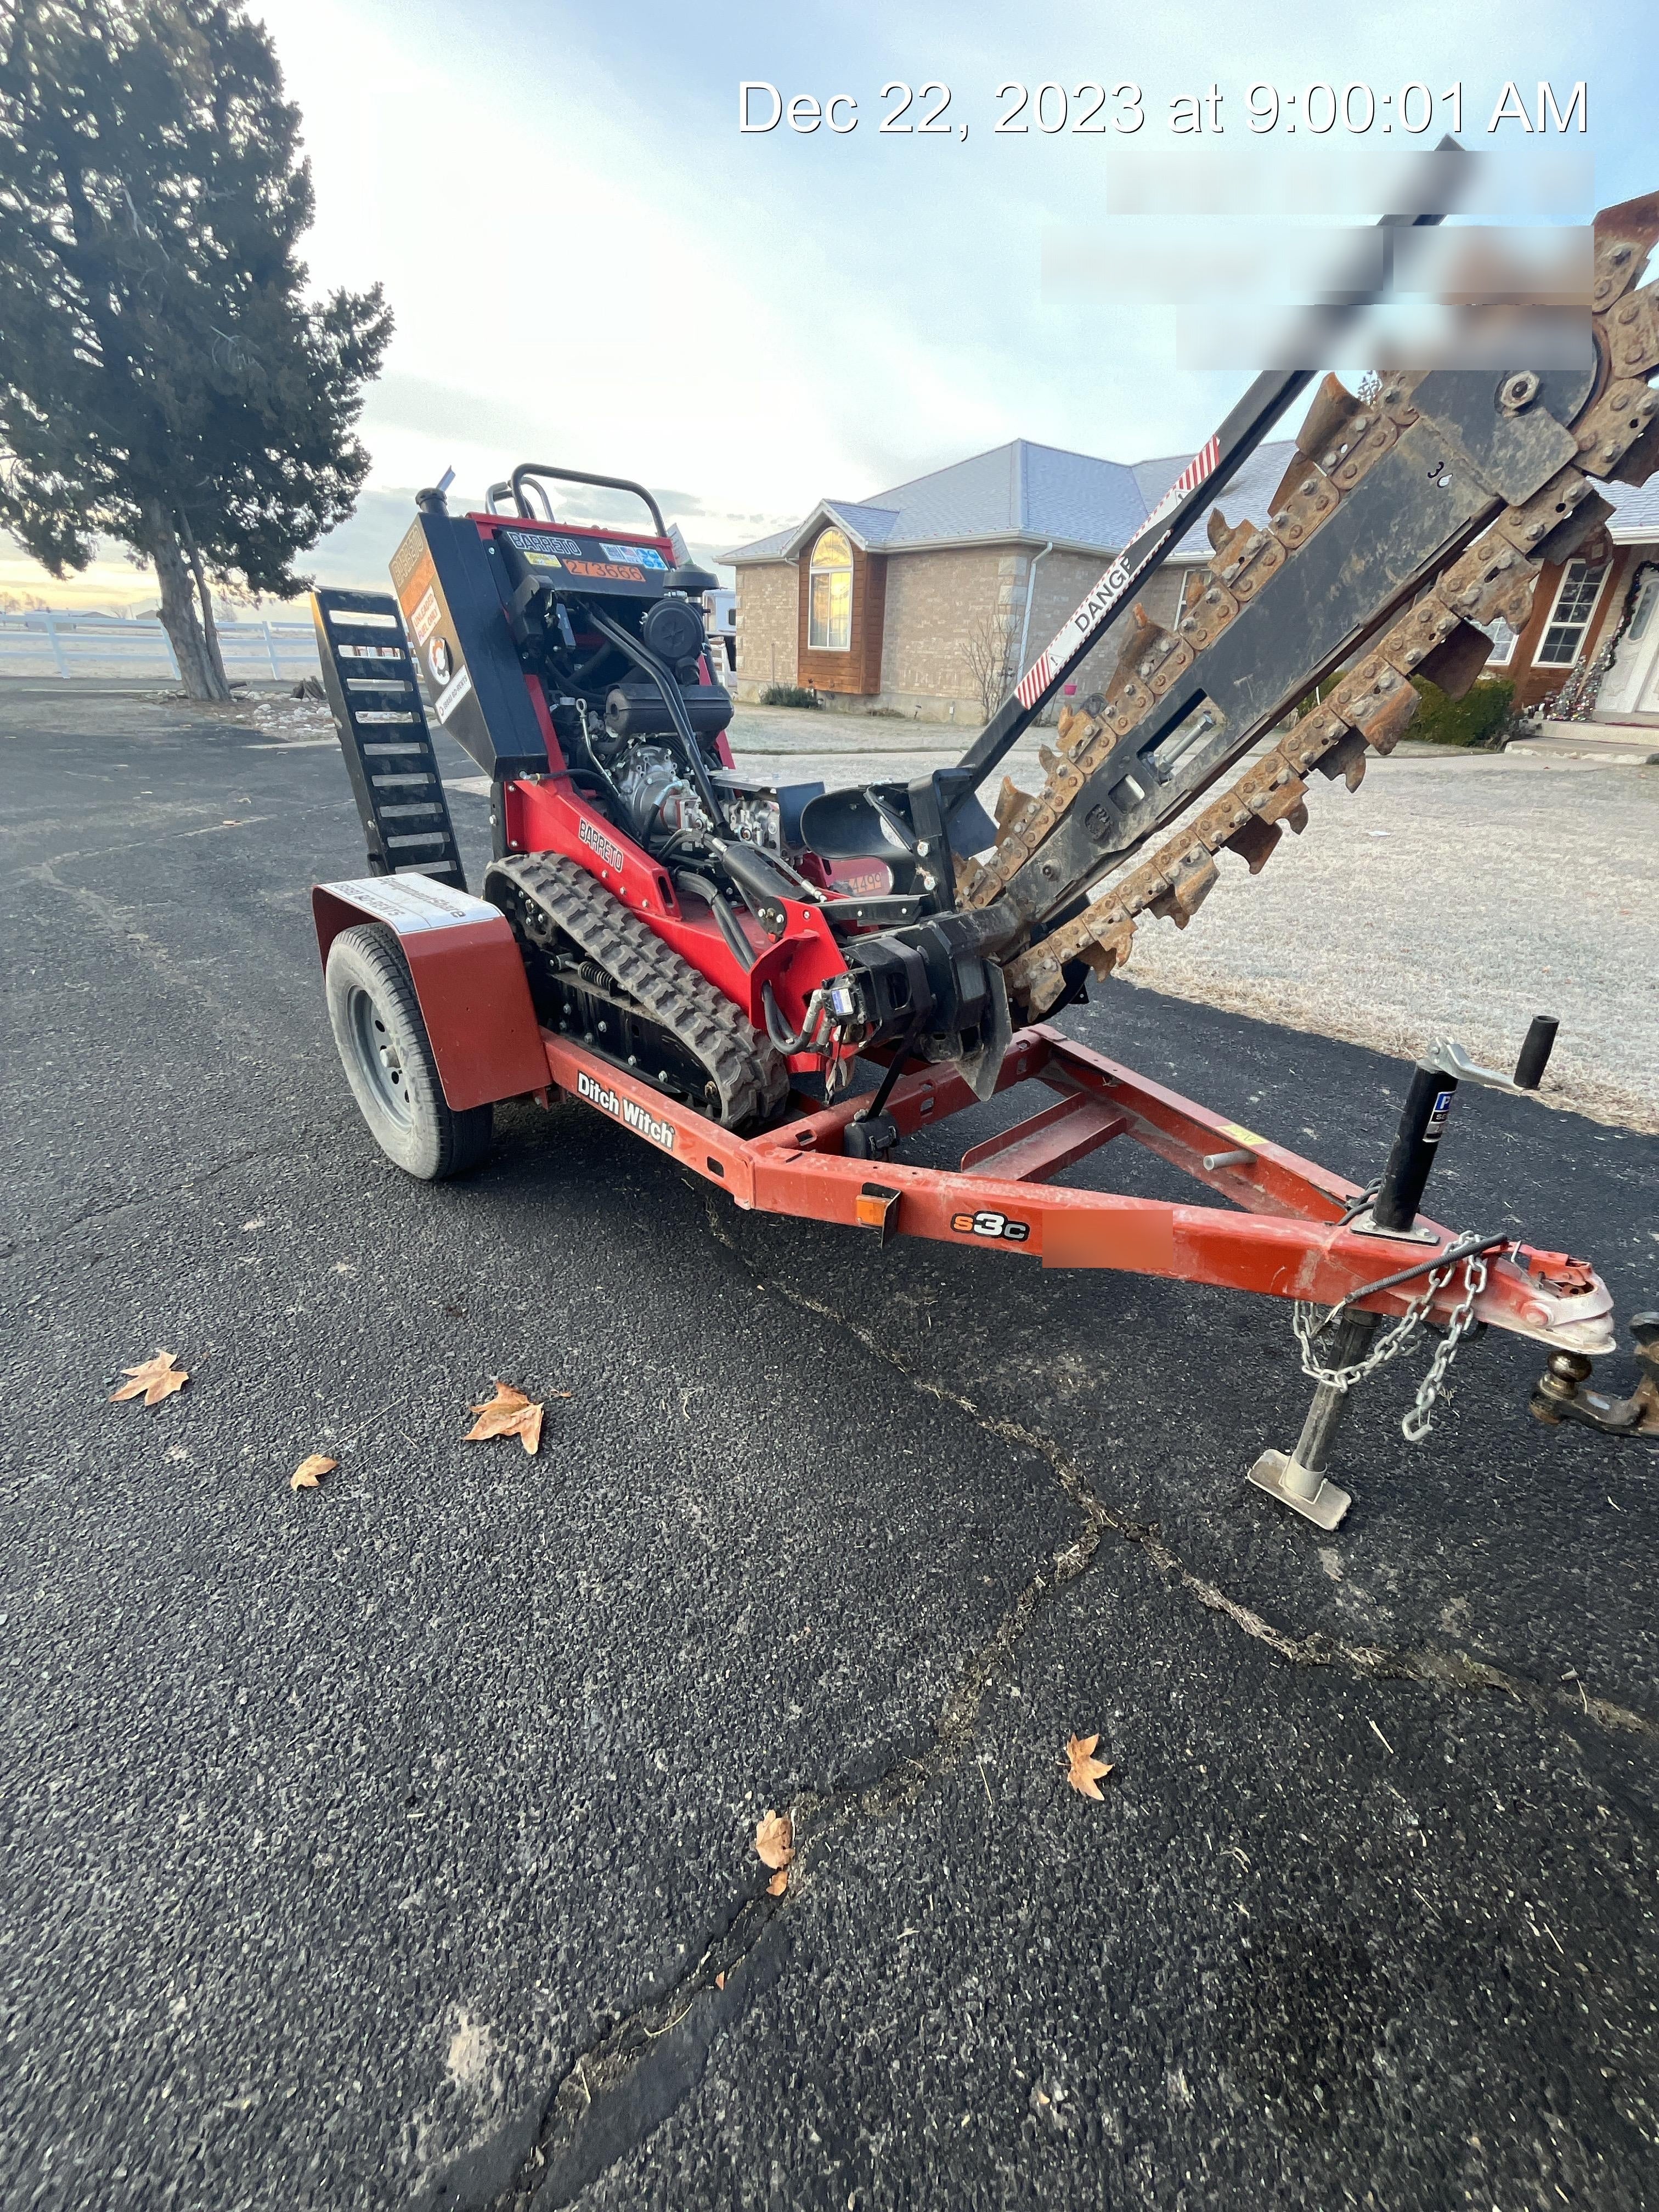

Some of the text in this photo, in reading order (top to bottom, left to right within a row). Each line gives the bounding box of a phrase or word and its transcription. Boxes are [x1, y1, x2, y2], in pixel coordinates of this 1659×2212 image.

[391, 524, 424, 588] BARRETO
[506, 531, 582, 556] BARRETO
[566, 560, 642, 580] 273666
[414, 594, 434, 628] UNLEADED
[1074, 557, 1136, 633] DANGE
[579, 816, 624, 873] BARRETO
[577, 1071, 675, 1149] Ditch Witch
